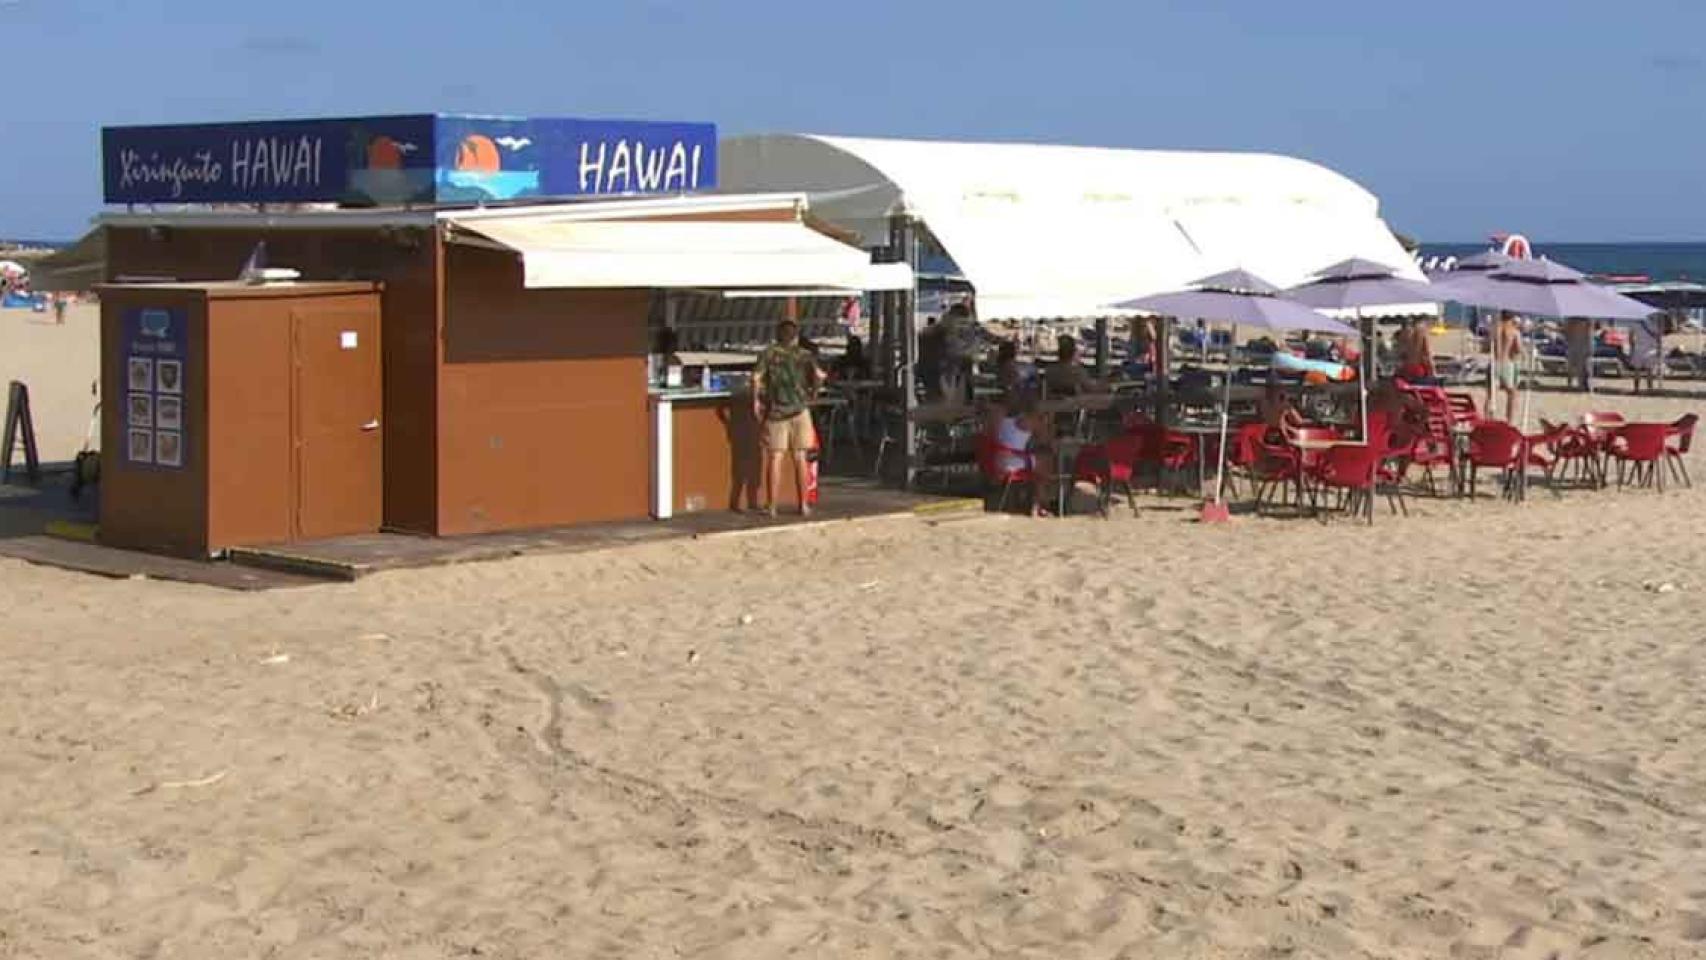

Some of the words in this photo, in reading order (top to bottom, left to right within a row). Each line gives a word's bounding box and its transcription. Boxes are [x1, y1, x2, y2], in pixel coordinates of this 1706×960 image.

[119, 148, 222, 198] Xiringuito
[231, 136, 322, 190] HAWAI
[578, 139, 701, 193] HAWAI
